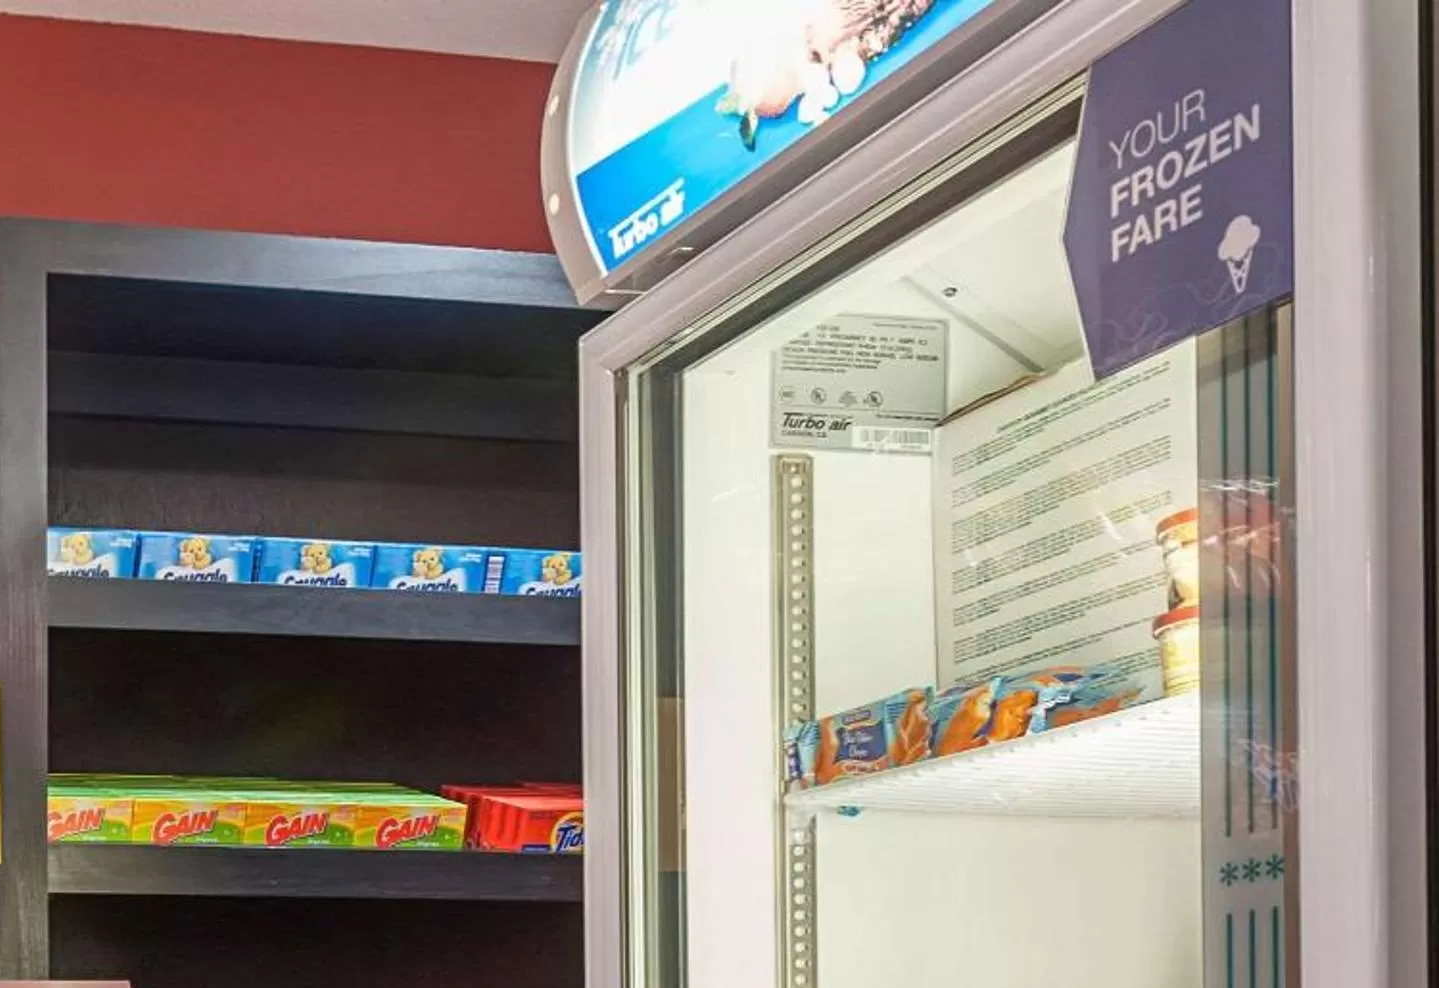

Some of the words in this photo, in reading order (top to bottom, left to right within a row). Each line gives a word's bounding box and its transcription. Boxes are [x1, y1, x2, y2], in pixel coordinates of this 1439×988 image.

[1110, 88, 1206, 170] YOUR
[1111, 103, 1261, 219] FROZEN
[1111, 184, 1204, 263] FARE
[782, 411, 826, 431] Turbo
[828, 415, 853, 431] air
[153, 810, 220, 845] GAIN
[265, 813, 329, 847] GAIN
[375, 814, 441, 849] GAIN
[556, 824, 584, 855] Tid
